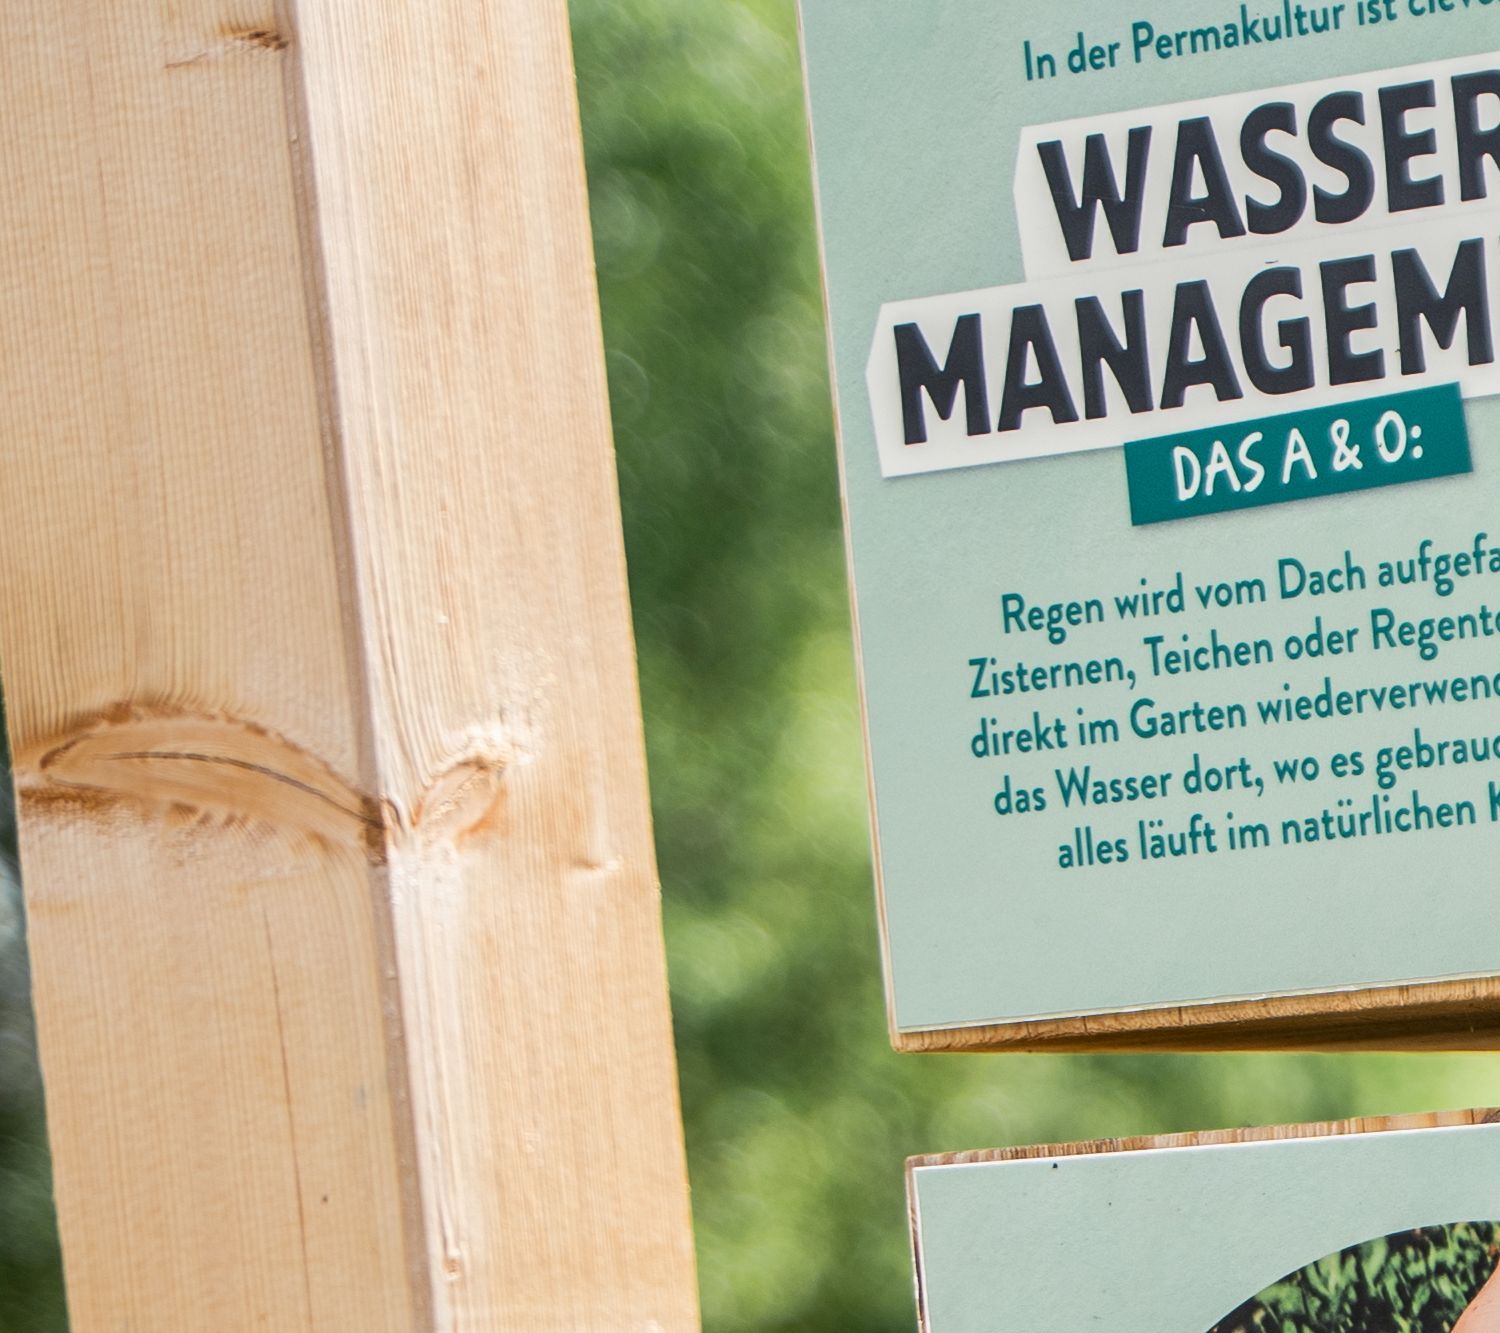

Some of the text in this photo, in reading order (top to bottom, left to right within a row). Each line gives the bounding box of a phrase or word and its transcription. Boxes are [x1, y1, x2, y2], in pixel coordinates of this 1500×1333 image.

[1022, 40, 1056, 81] In
[1068, 32, 1120, 71] der
[1132, 4, 1345, 64] Permakultur
[1173, 411, 1422, 502] DAS A & O:
[1002, 593, 1104, 644] Regen
[1114, 572, 1185, 618] wird
[1195, 575, 1266, 609] vom
[1278, 550, 1366, 599] Dach
[969, 655, 1136, 698] Zisternen,
[1144, 629, 1273, 676] Teichen
[1284, 616, 1359, 660] oder
[971, 712, 1068, 758] direkt
[1078, 708, 1119, 745] im
[1130, 697, 1247, 739] Garten
[994, 775, 1046, 815] das
[1056, 765, 1172, 807] Wasser
[1183, 754, 1265, 796] dort,
[1274, 756, 1320, 783] wo
[1331, 751, 1365, 778] es
[1058, 827, 1128, 869] alles
[1139, 814, 1217, 860] läuft
[1227, 812, 1269, 850] im
[1282, 790, 1476, 846] natürlichen
